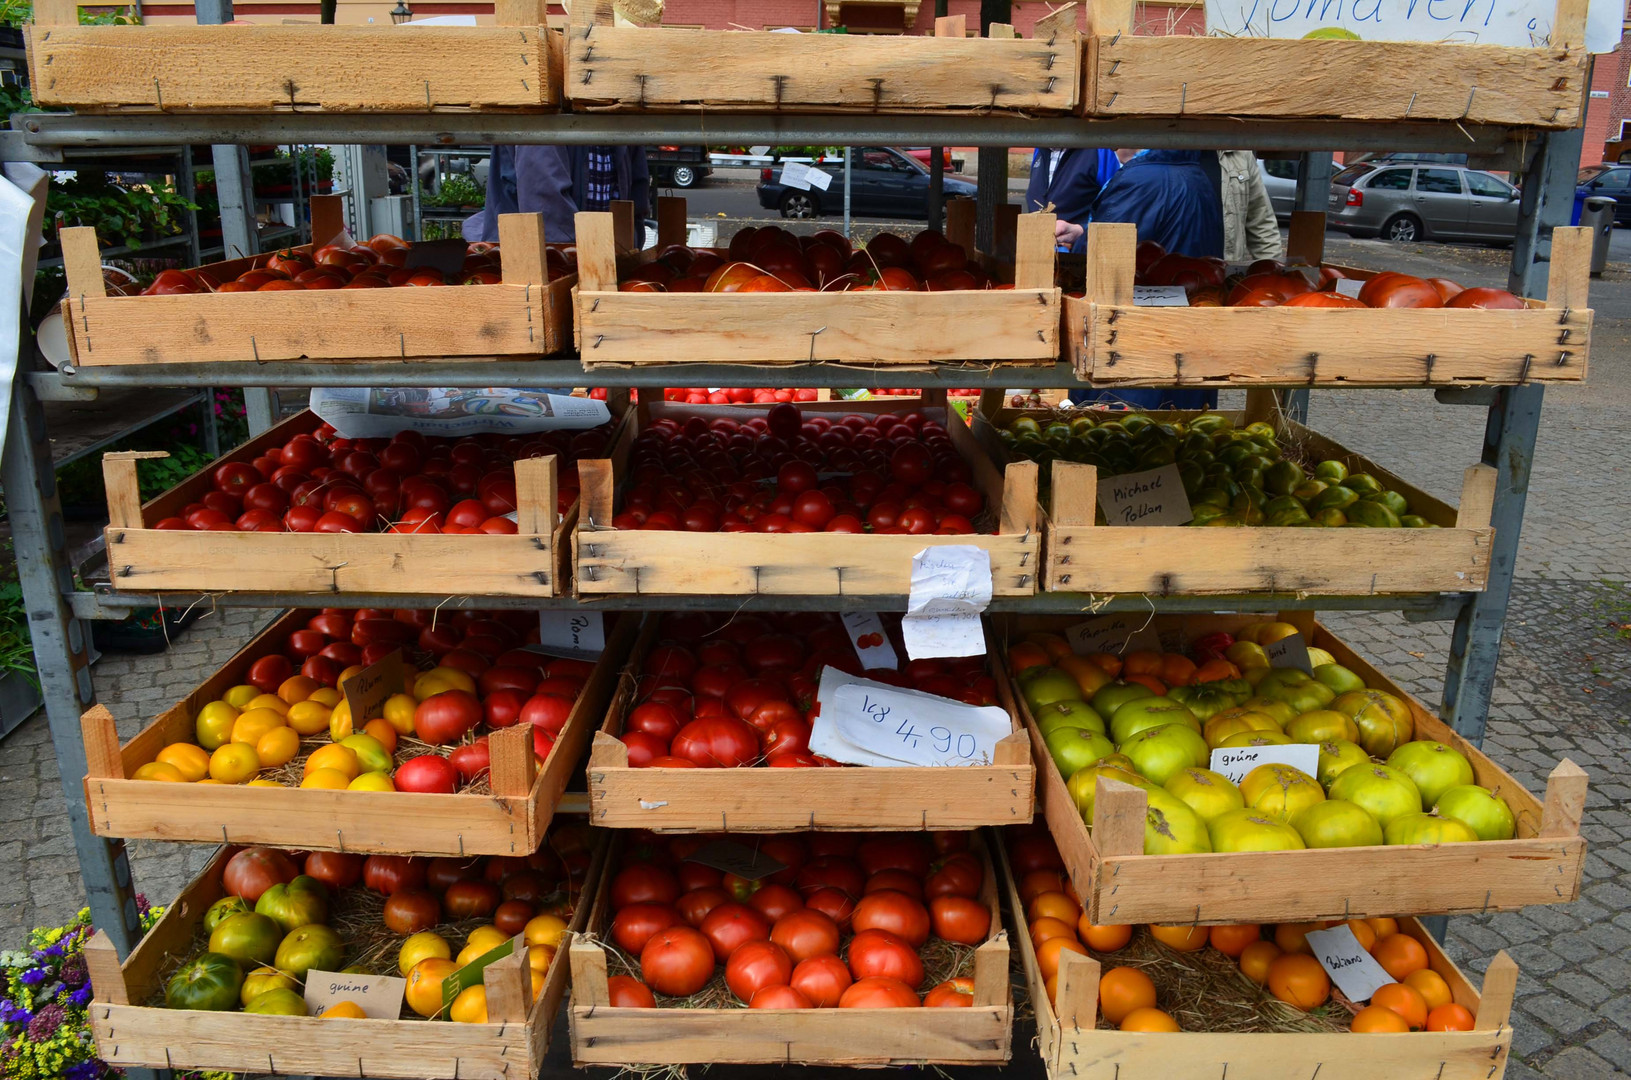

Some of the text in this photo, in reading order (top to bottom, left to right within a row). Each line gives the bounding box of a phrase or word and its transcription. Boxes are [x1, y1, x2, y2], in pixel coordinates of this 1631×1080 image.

[1113, 475, 1162, 503] Michael
[1120, 503, 1163, 523] Pollan
[862, 694, 976, 758] kg 4,90
[1222, 750, 1259, 766] grüne
